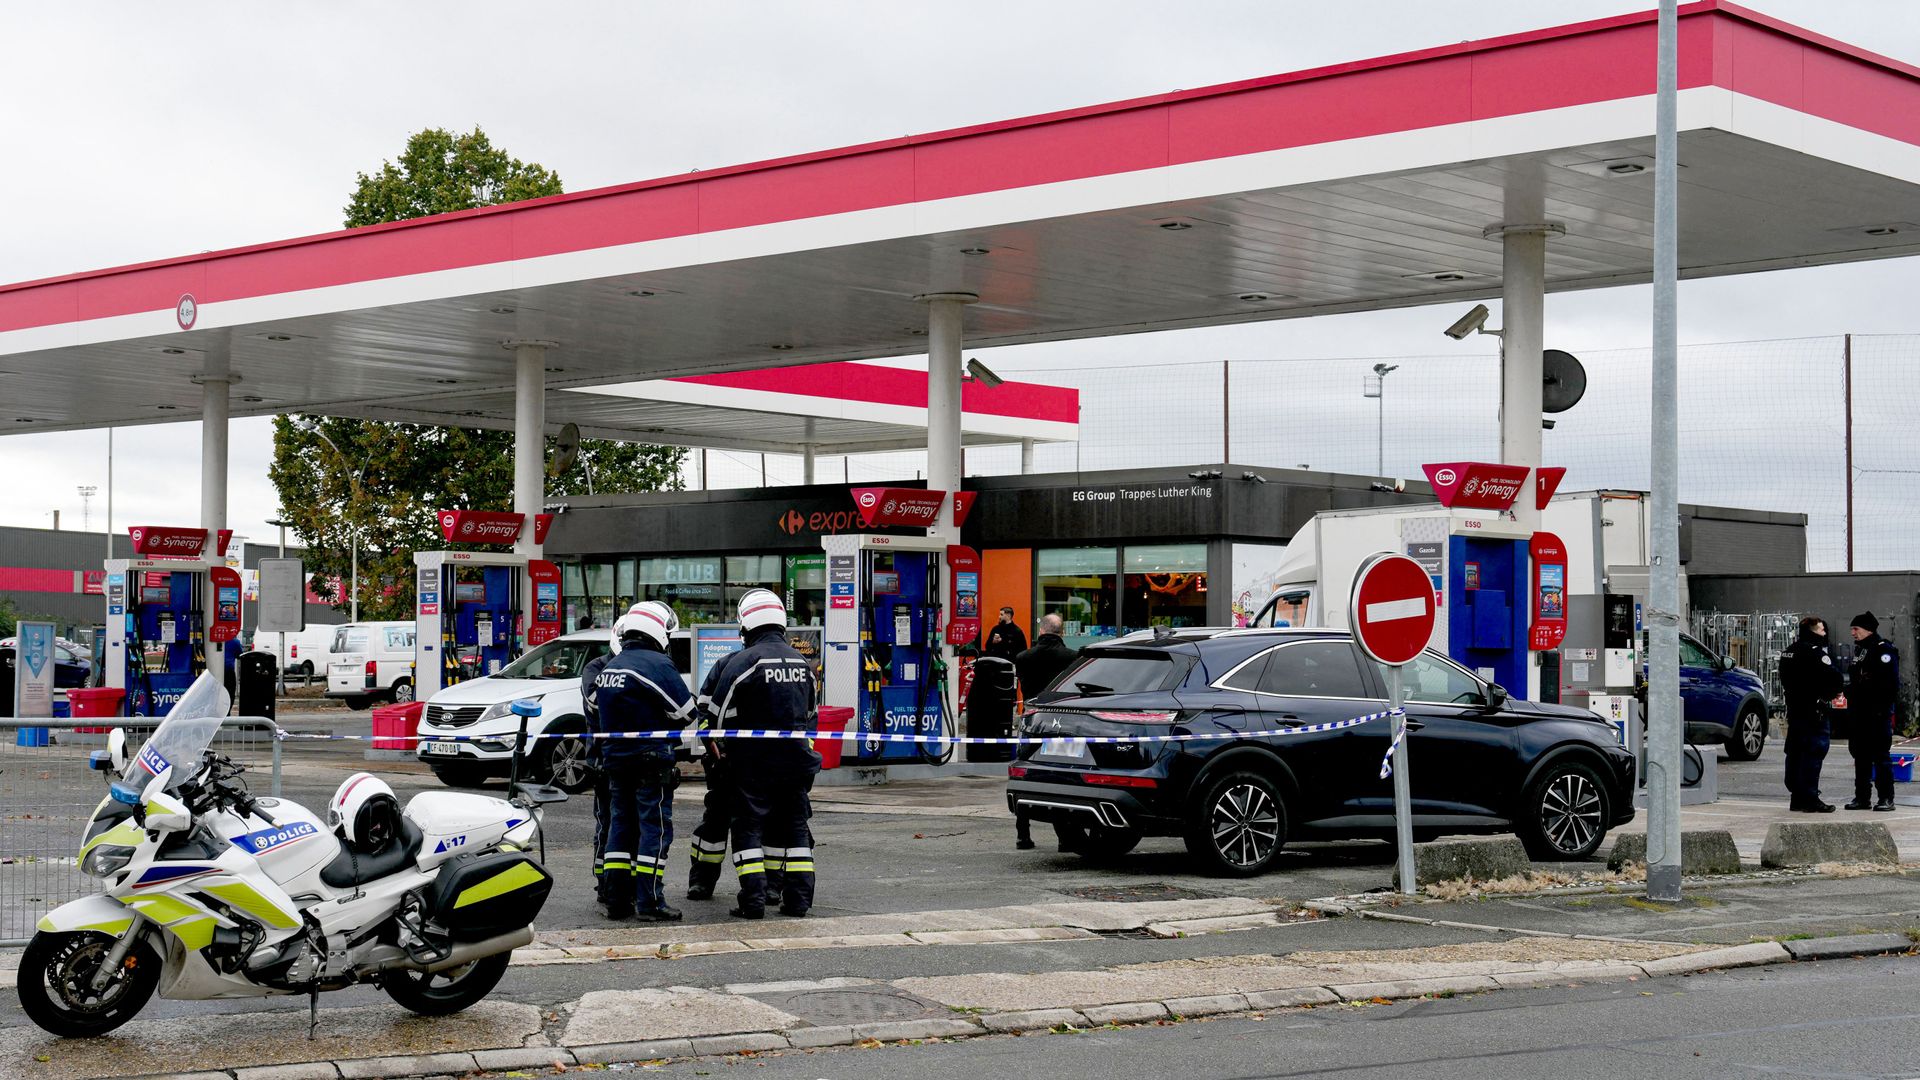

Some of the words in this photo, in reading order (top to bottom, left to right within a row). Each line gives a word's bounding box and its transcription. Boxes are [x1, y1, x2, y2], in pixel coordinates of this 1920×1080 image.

[1540, 477, 1545, 490] 1
[1072, 491, 1084, 501] EG
[1087, 491, 1116, 502] Group
[1120, 489, 1156, 500] Trappes
[1158, 487, 1188, 498] Luther
[1191, 486, 1212, 497] King
[1478, 481, 1517, 500] Synergy
[898, 502, 936, 518] Synergy
[956, 500, 962, 510] 3
[476, 523, 517, 536] Synergy
[536, 522, 541, 530] 5
[1464, 520, 1482, 528] ESSO
[163, 538, 201, 549] Synergy
[219, 536, 222, 544] 7
[665, 564, 715, 582] CLUB
[919, 610, 924, 618] 3
[704, 644, 732, 652] Adoptez
[764, 668, 807, 682] POLICE
[152, 691, 182, 707] Syne
[885, 711, 938, 731] Synegy
[268, 823, 312, 845] POLICE
[451, 835, 466, 846] 17
